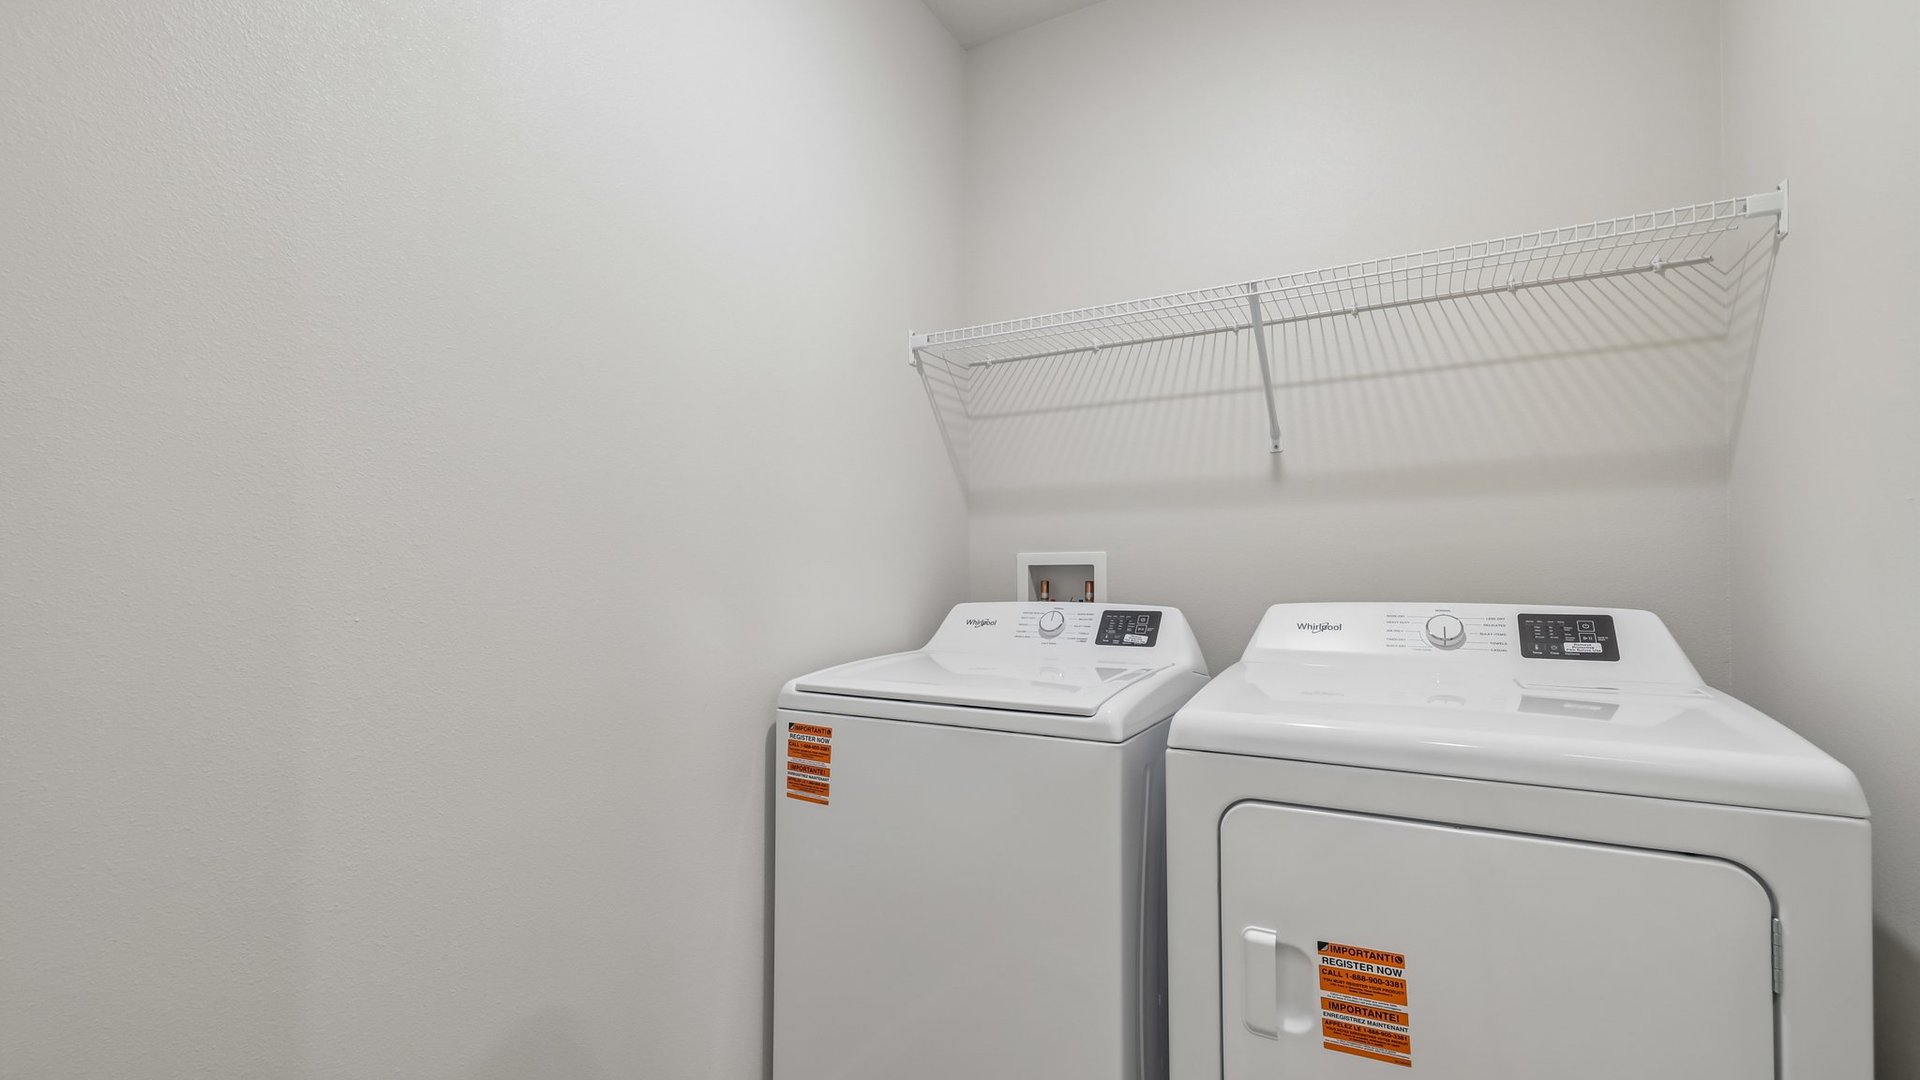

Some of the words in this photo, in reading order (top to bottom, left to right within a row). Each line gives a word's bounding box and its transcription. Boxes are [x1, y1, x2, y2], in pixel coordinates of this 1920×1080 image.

[966, 619, 997, 628] Whirlpool
[1296, 622, 1342, 634] Whirlpool
[790, 733, 816, 742] REGISTER
[1330, 945, 1394, 963] IMPORTANT!
[1322, 957, 1374, 973] REGISTER
[1377, 966, 1402, 977] NOW
[1322, 968, 1343, 978] CALL
[1345, 973, 1403, 989] 1-888-900-3381
[1328, 1002, 1400, 1022] IMPORTANTE!
[1323, 1012, 1365, 1024] ENREGISTREZ
[1367, 1020, 1408, 1033] MAINTENANT
[1325, 1020, 1353, 1030] APPELEZ
